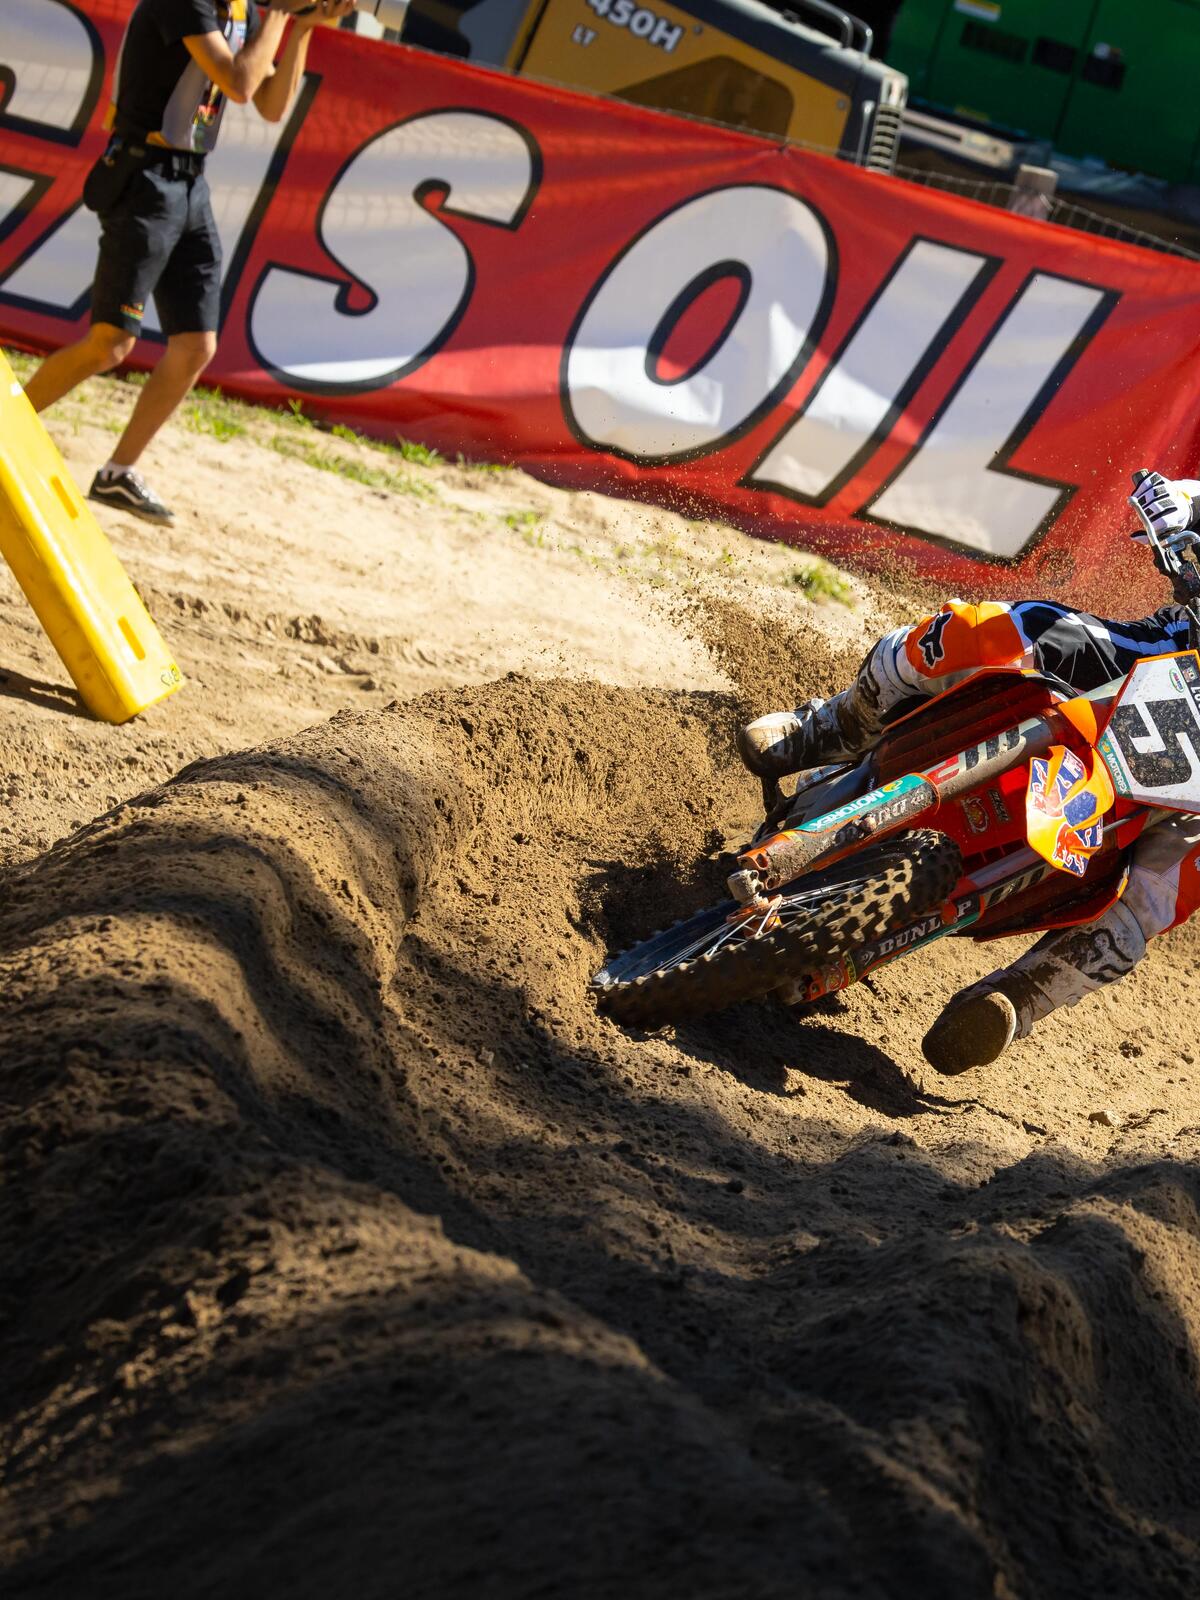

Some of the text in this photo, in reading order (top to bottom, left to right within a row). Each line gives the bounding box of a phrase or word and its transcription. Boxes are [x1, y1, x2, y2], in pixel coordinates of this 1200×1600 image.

[563, 183, 1123, 560] OIL
[807, 790, 887, 832] MOTOREX
[879, 900, 972, 950] DUNLP
